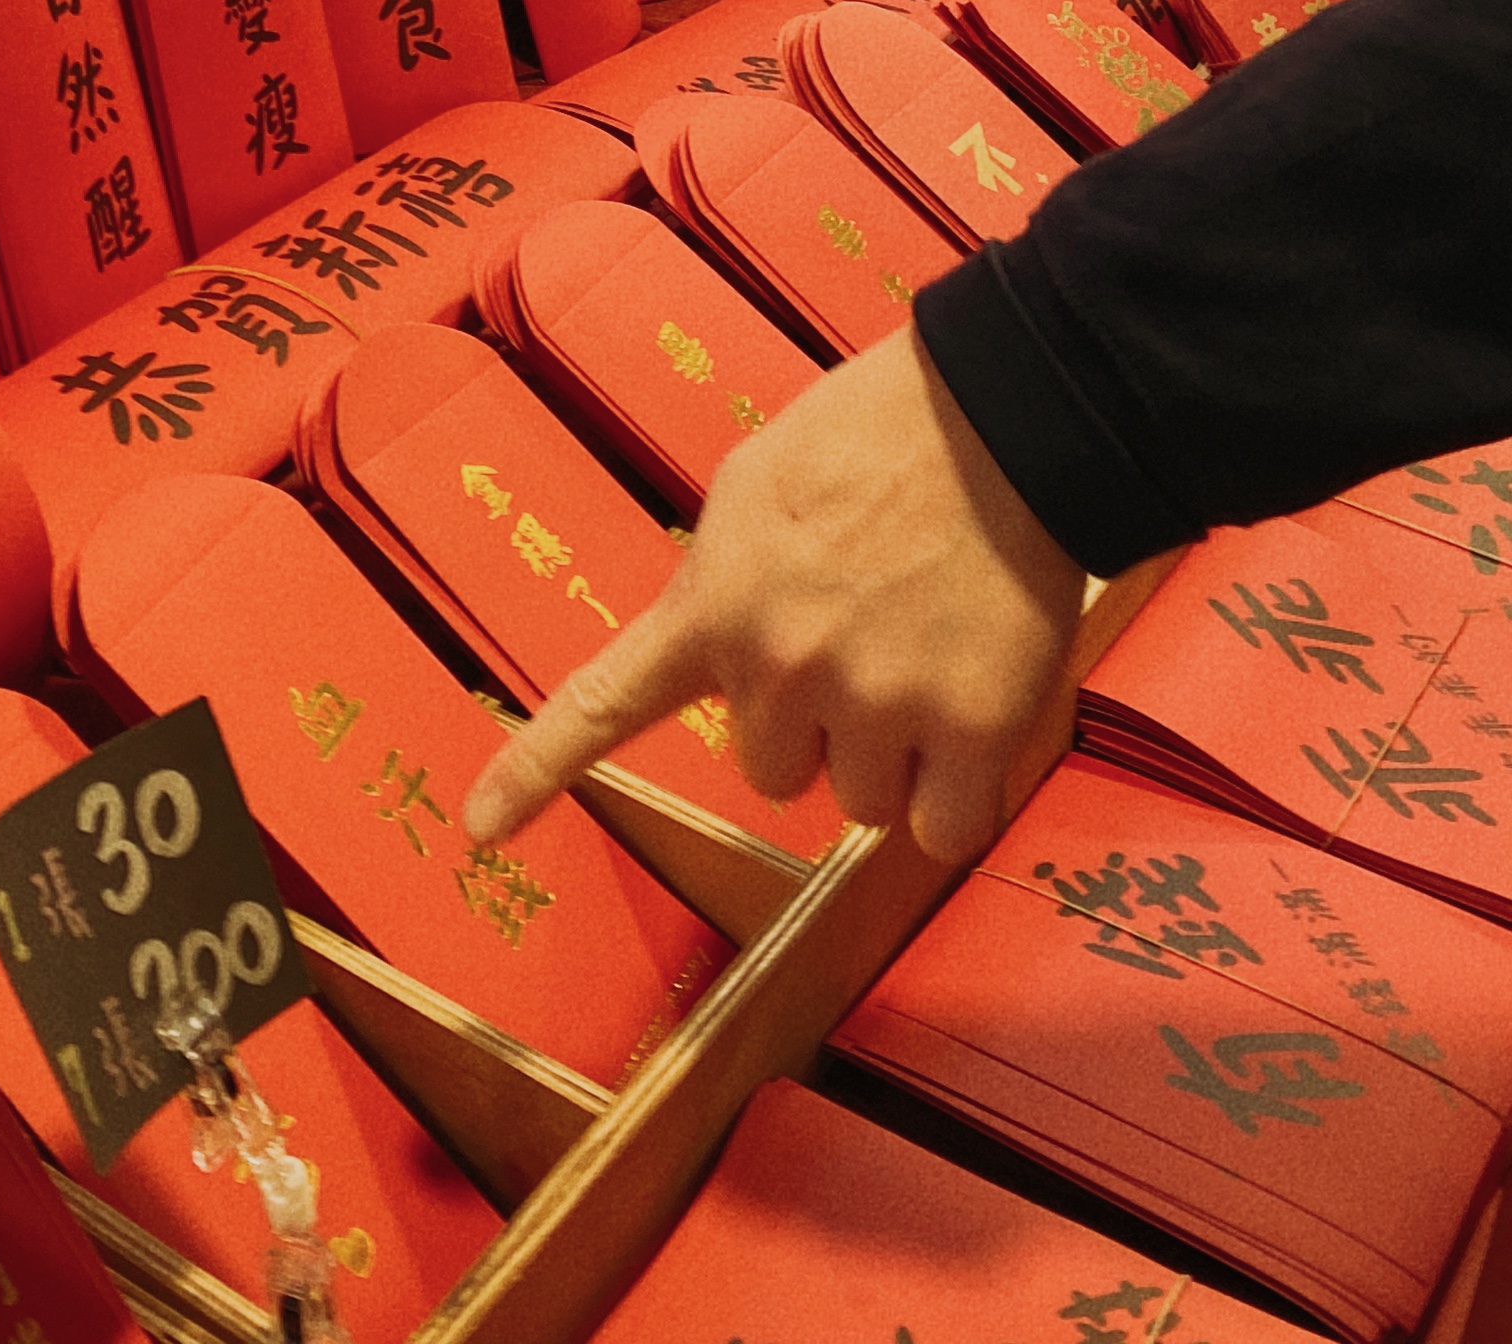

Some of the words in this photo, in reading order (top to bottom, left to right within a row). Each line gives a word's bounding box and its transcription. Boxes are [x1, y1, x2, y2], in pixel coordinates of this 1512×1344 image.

[49, 153, 516, 447] 恭賀新禧
[1208, 576, 1498, 828] 乖乖
